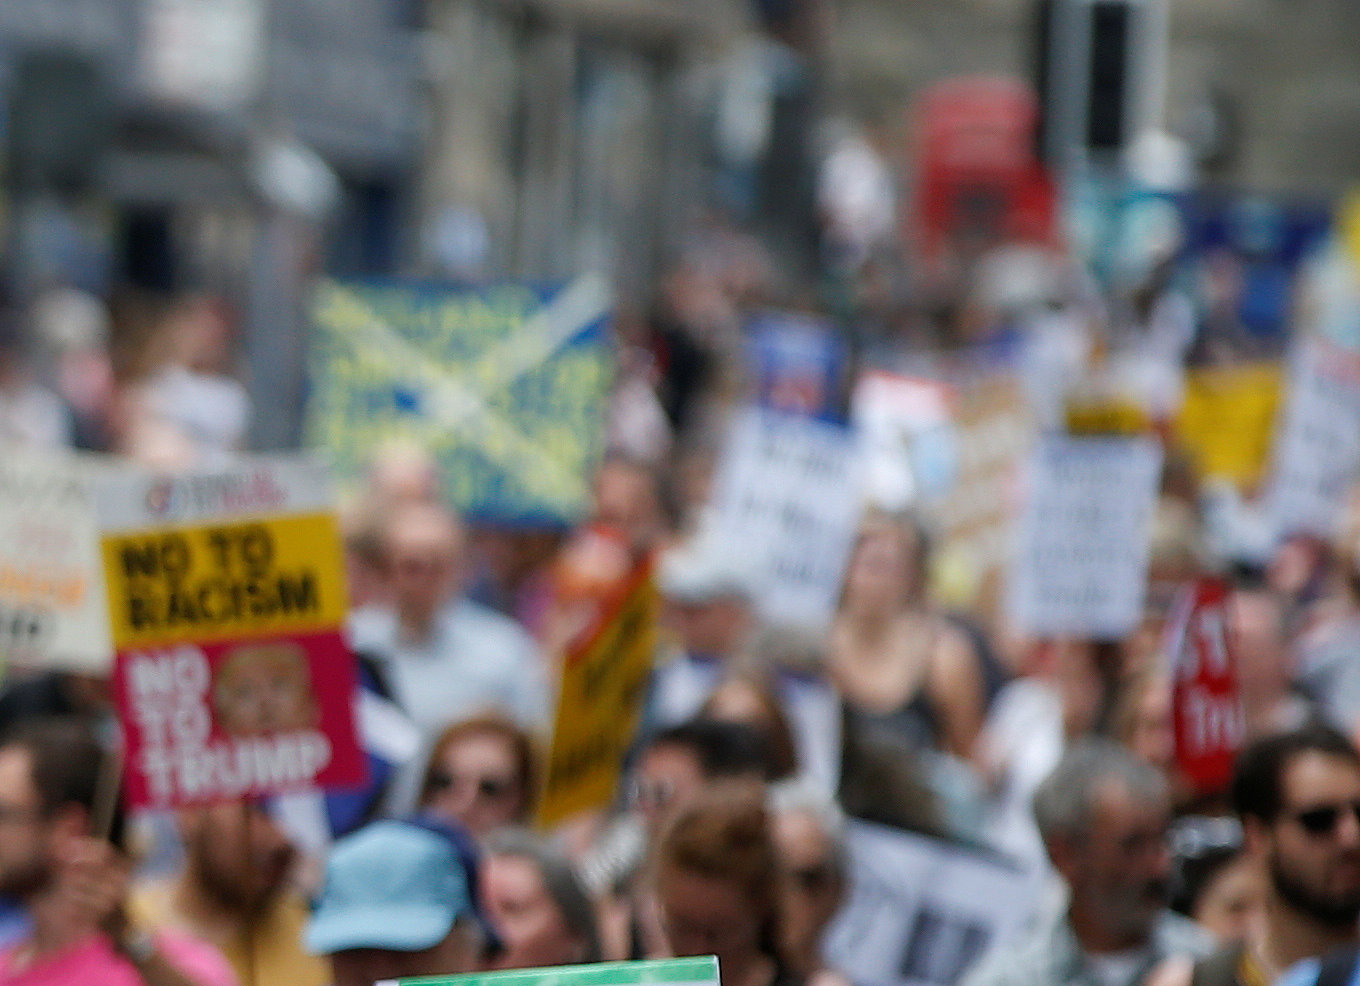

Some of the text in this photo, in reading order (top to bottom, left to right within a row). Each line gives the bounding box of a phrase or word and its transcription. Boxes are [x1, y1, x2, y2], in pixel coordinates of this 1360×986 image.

[120, 533, 191, 578] NO
[209, 523, 275, 577] TO
[128, 570, 320, 632] RACISM
[127, 642, 211, 696] NO
[136, 696, 211, 748] TO
[141, 730, 334, 805] TRUMP
